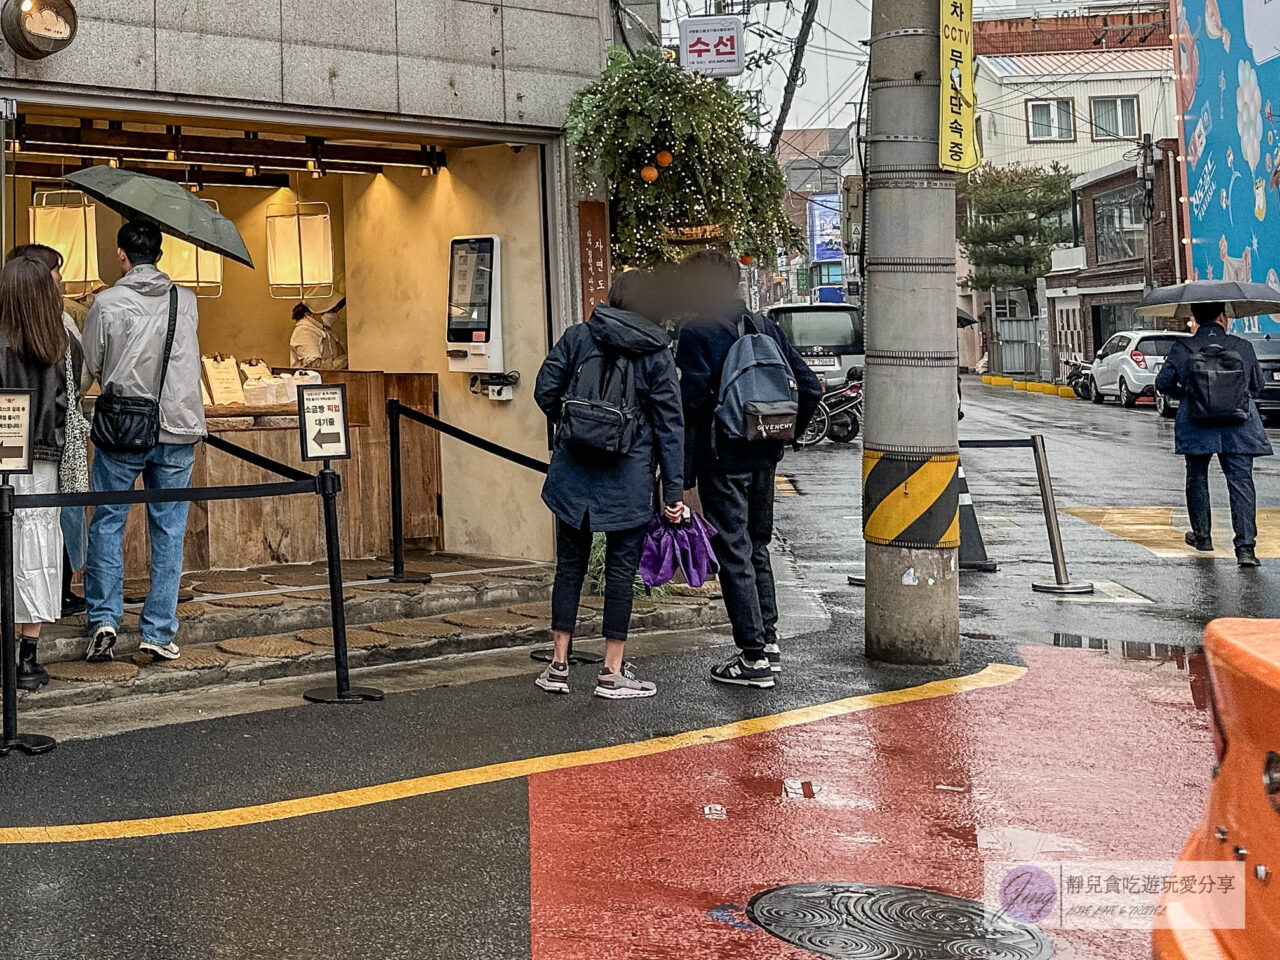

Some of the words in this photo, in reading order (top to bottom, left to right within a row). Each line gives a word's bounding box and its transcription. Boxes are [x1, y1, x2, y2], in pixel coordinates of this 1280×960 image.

[943, 23, 970, 45] CCTV
[689, 35, 736, 58] 수선
[305, 405, 325, 413] 소금빵
[314, 417, 335, 426] 대기줄
